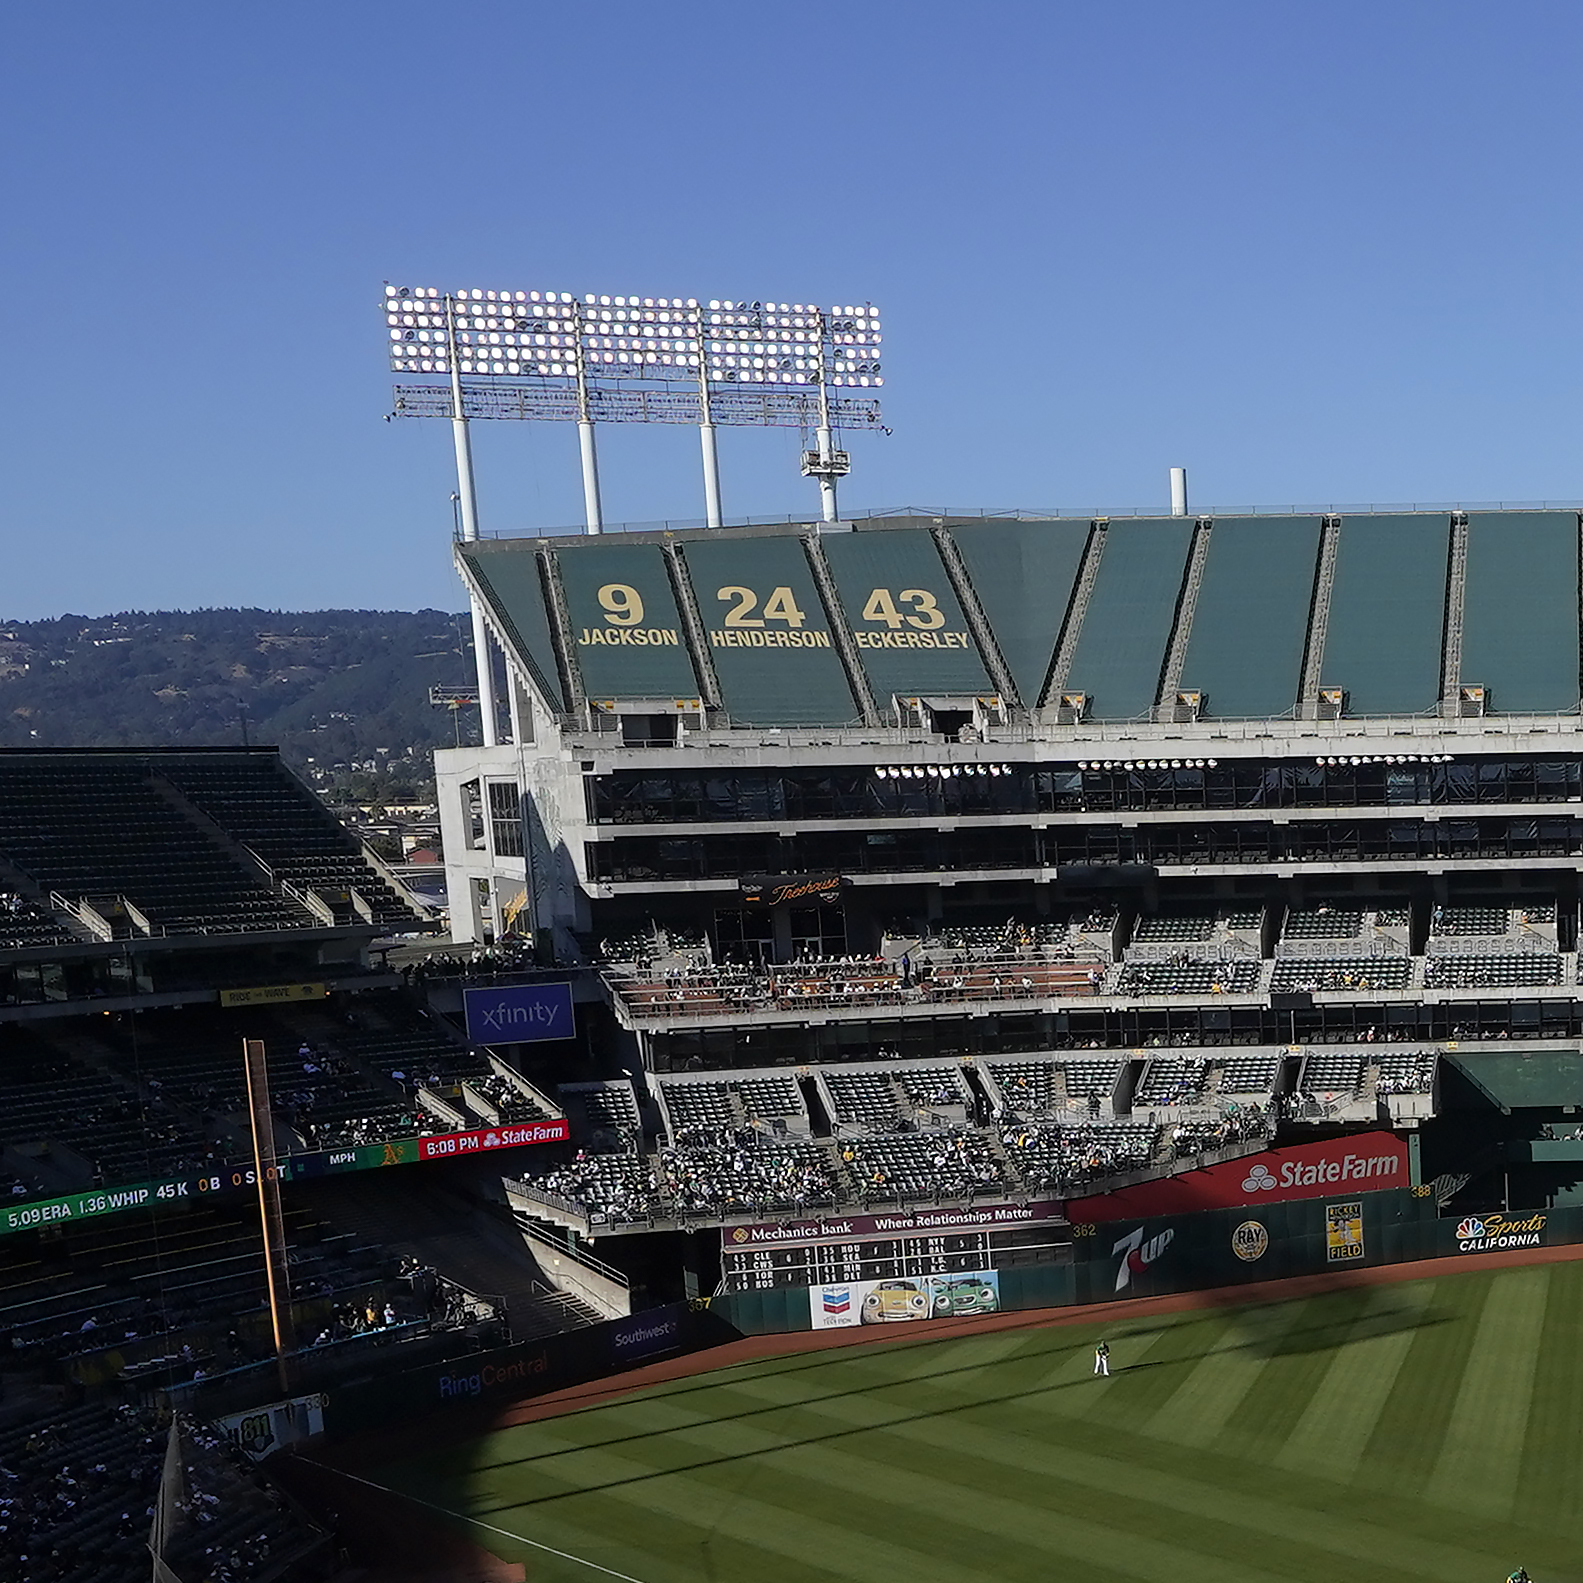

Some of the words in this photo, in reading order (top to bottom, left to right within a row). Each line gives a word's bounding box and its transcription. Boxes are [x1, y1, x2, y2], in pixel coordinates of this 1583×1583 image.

[597, 583, 645, 626] 9
[716, 586, 805, 628] 24
[861, 588, 946, 630] 43
[579, 628, 677, 645] JACKSON
[711, 630, 831, 647] HENDERSON
[856, 632, 969, 649] ECKERSLEY
[482, 1002, 558, 1030] xfinity
[381, 1144, 403, 1165] A's
[427, 1140, 455, 1156] 6:08
[460, 1137, 479, 1150] PM
[330, 1152, 356, 1165] MPH
[1411, 1184, 1431, 1197] 388
[8, 1209, 40, 1227] 5.09
[42, 1203, 71, 1220] ERA
[80, 1198, 105, 1214] 1.36
[108, 1189, 149, 1207] WHIP
[156, 1185, 176, 1199] 45
[178, 1182, 188, 1195] K
[1329, 1206, 1360, 1216] RICKEY
[875, 1218, 914, 1230] Where
[916, 1212, 992, 1228] Relationships
[995, 1208, 1033, 1220] Matter
[1484, 1214, 1547, 1238] Sports
[752, 1227, 818, 1241] Mechanics
[822, 1222, 852, 1234] Bank
[1073, 1224, 1096, 1238] 362
[1238, 1229, 1261, 1243] RAY
[1459, 1233, 1540, 1251] CALIFORNIA
[1330, 1245, 1361, 1259] FIELD
[615, 1321, 670, 1347] Southwest
[438, 1354, 547, 1398] RingCentral
